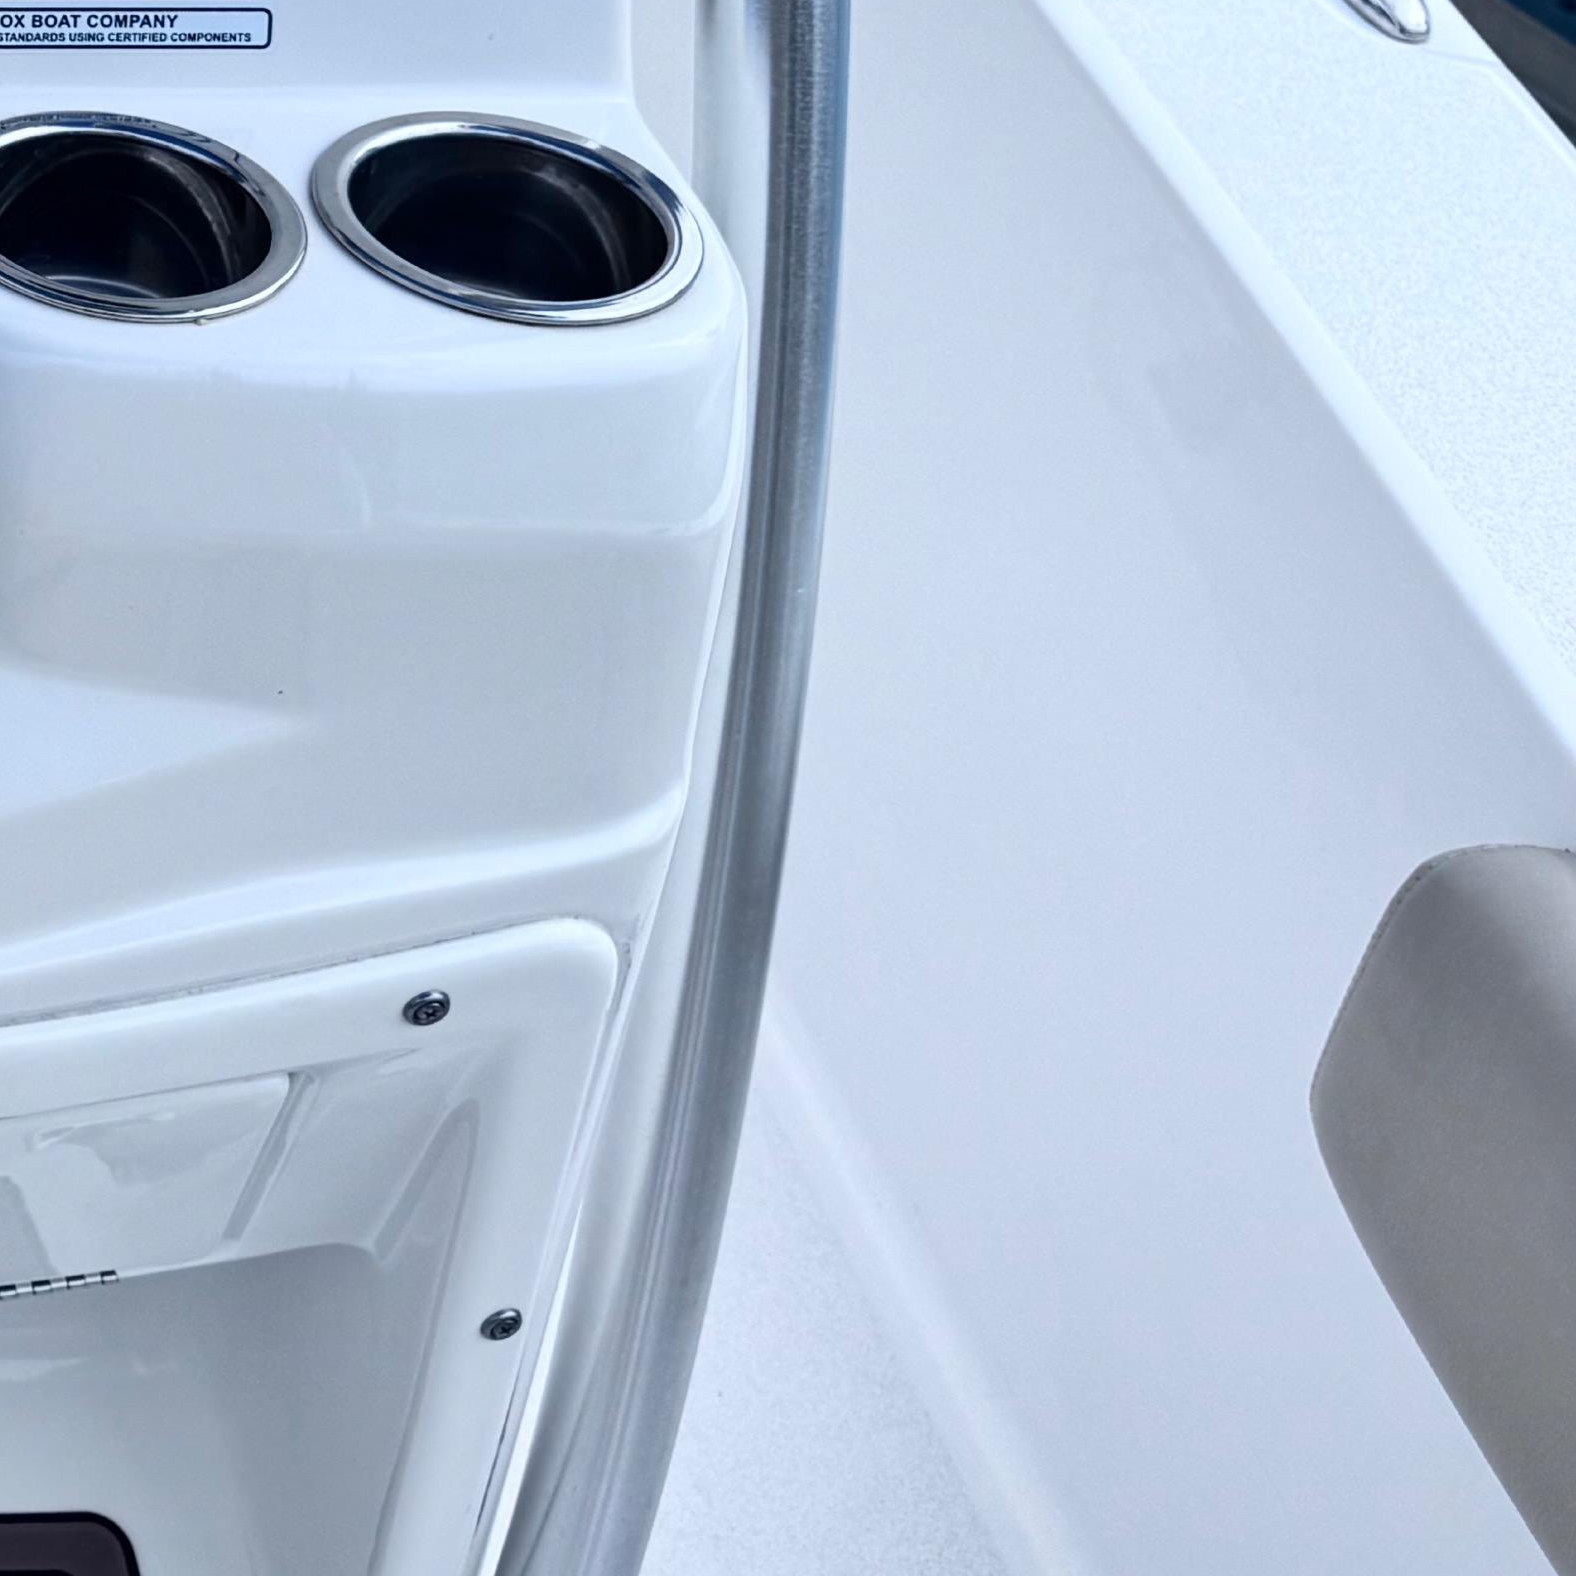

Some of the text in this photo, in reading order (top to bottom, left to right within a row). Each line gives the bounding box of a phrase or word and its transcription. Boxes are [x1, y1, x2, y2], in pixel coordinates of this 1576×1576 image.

[31, 14, 81, 28] BOAT
[86, 14, 178, 28] COMPANY
[68, 32, 104, 42] USING
[107, 32, 167, 42] CERTIFIED
[170, 32, 251, 42] COMPONENTS
